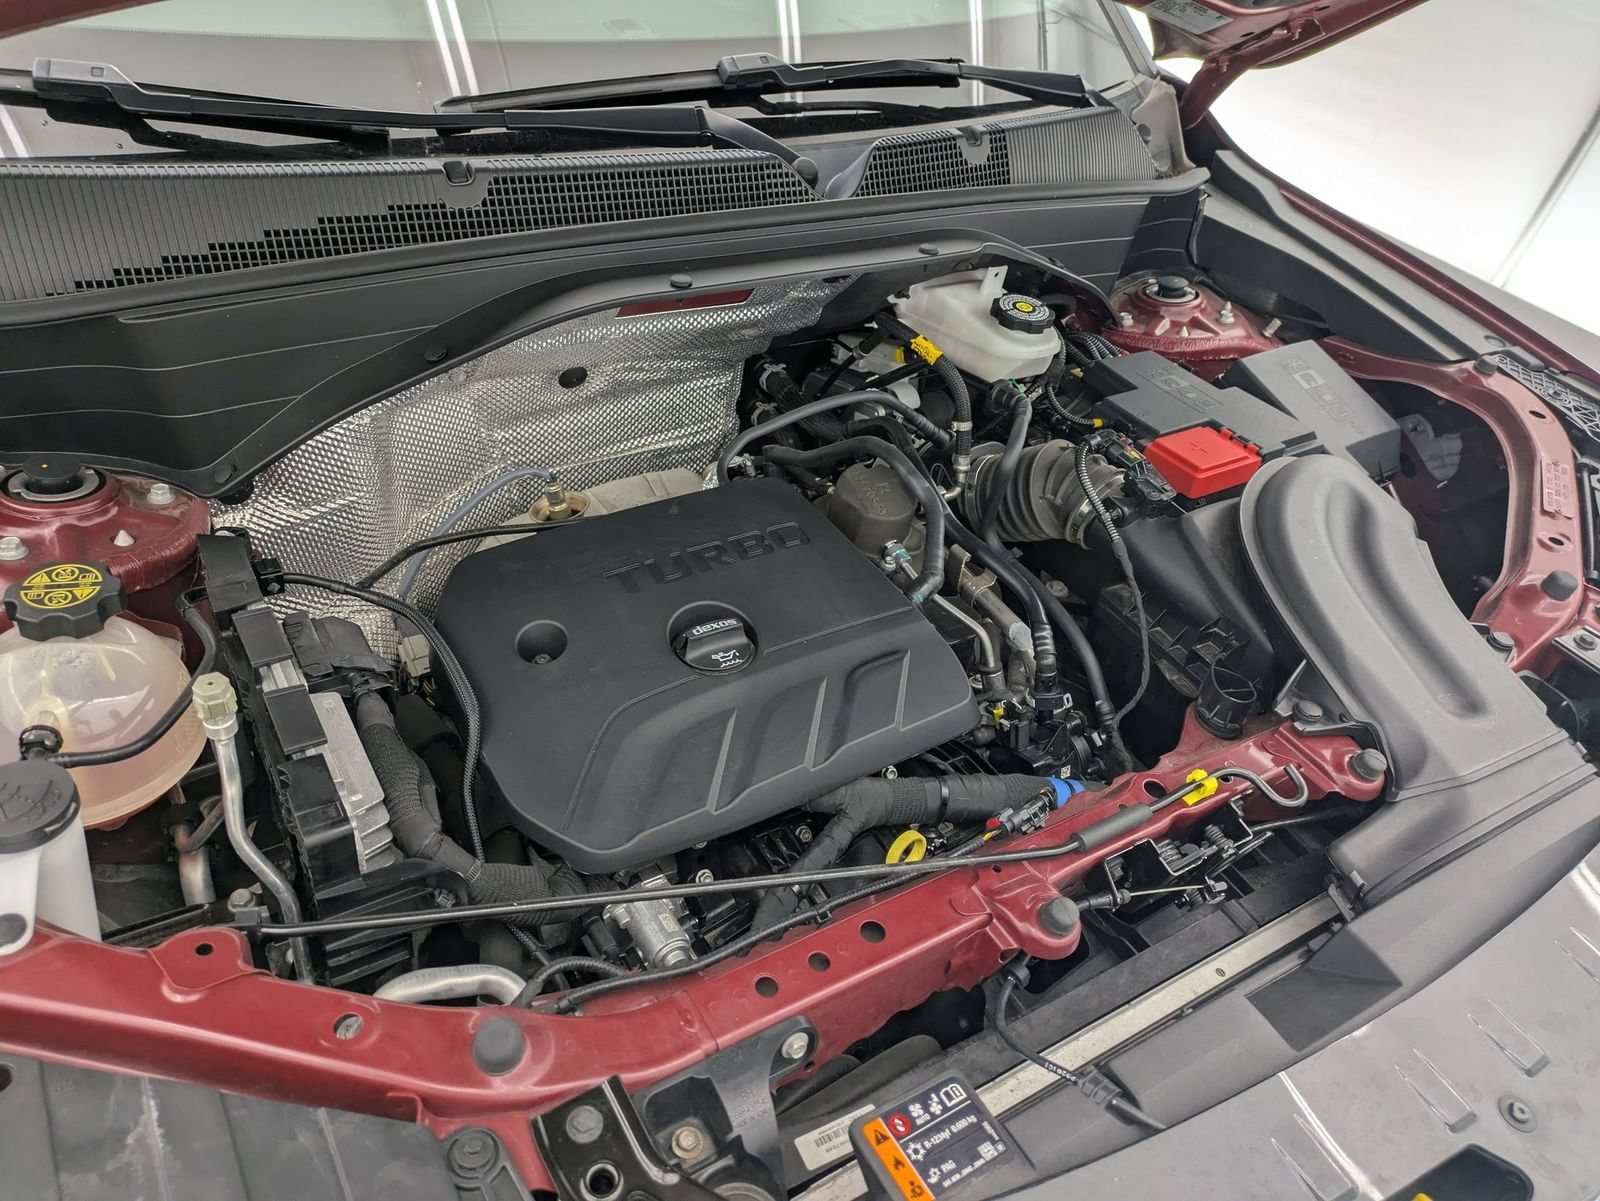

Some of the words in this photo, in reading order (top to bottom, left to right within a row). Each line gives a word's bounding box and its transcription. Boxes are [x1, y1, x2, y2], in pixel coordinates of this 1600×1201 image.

[603, 521, 811, 594] TURBO
[691, 618, 738, 636] dexos
[915, 1113, 931, 1126] AUTO
[923, 1128, 952, 1149] R-1234yf
[967, 1114, 978, 1125] kg
[940, 1160, 957, 1173] PAG
